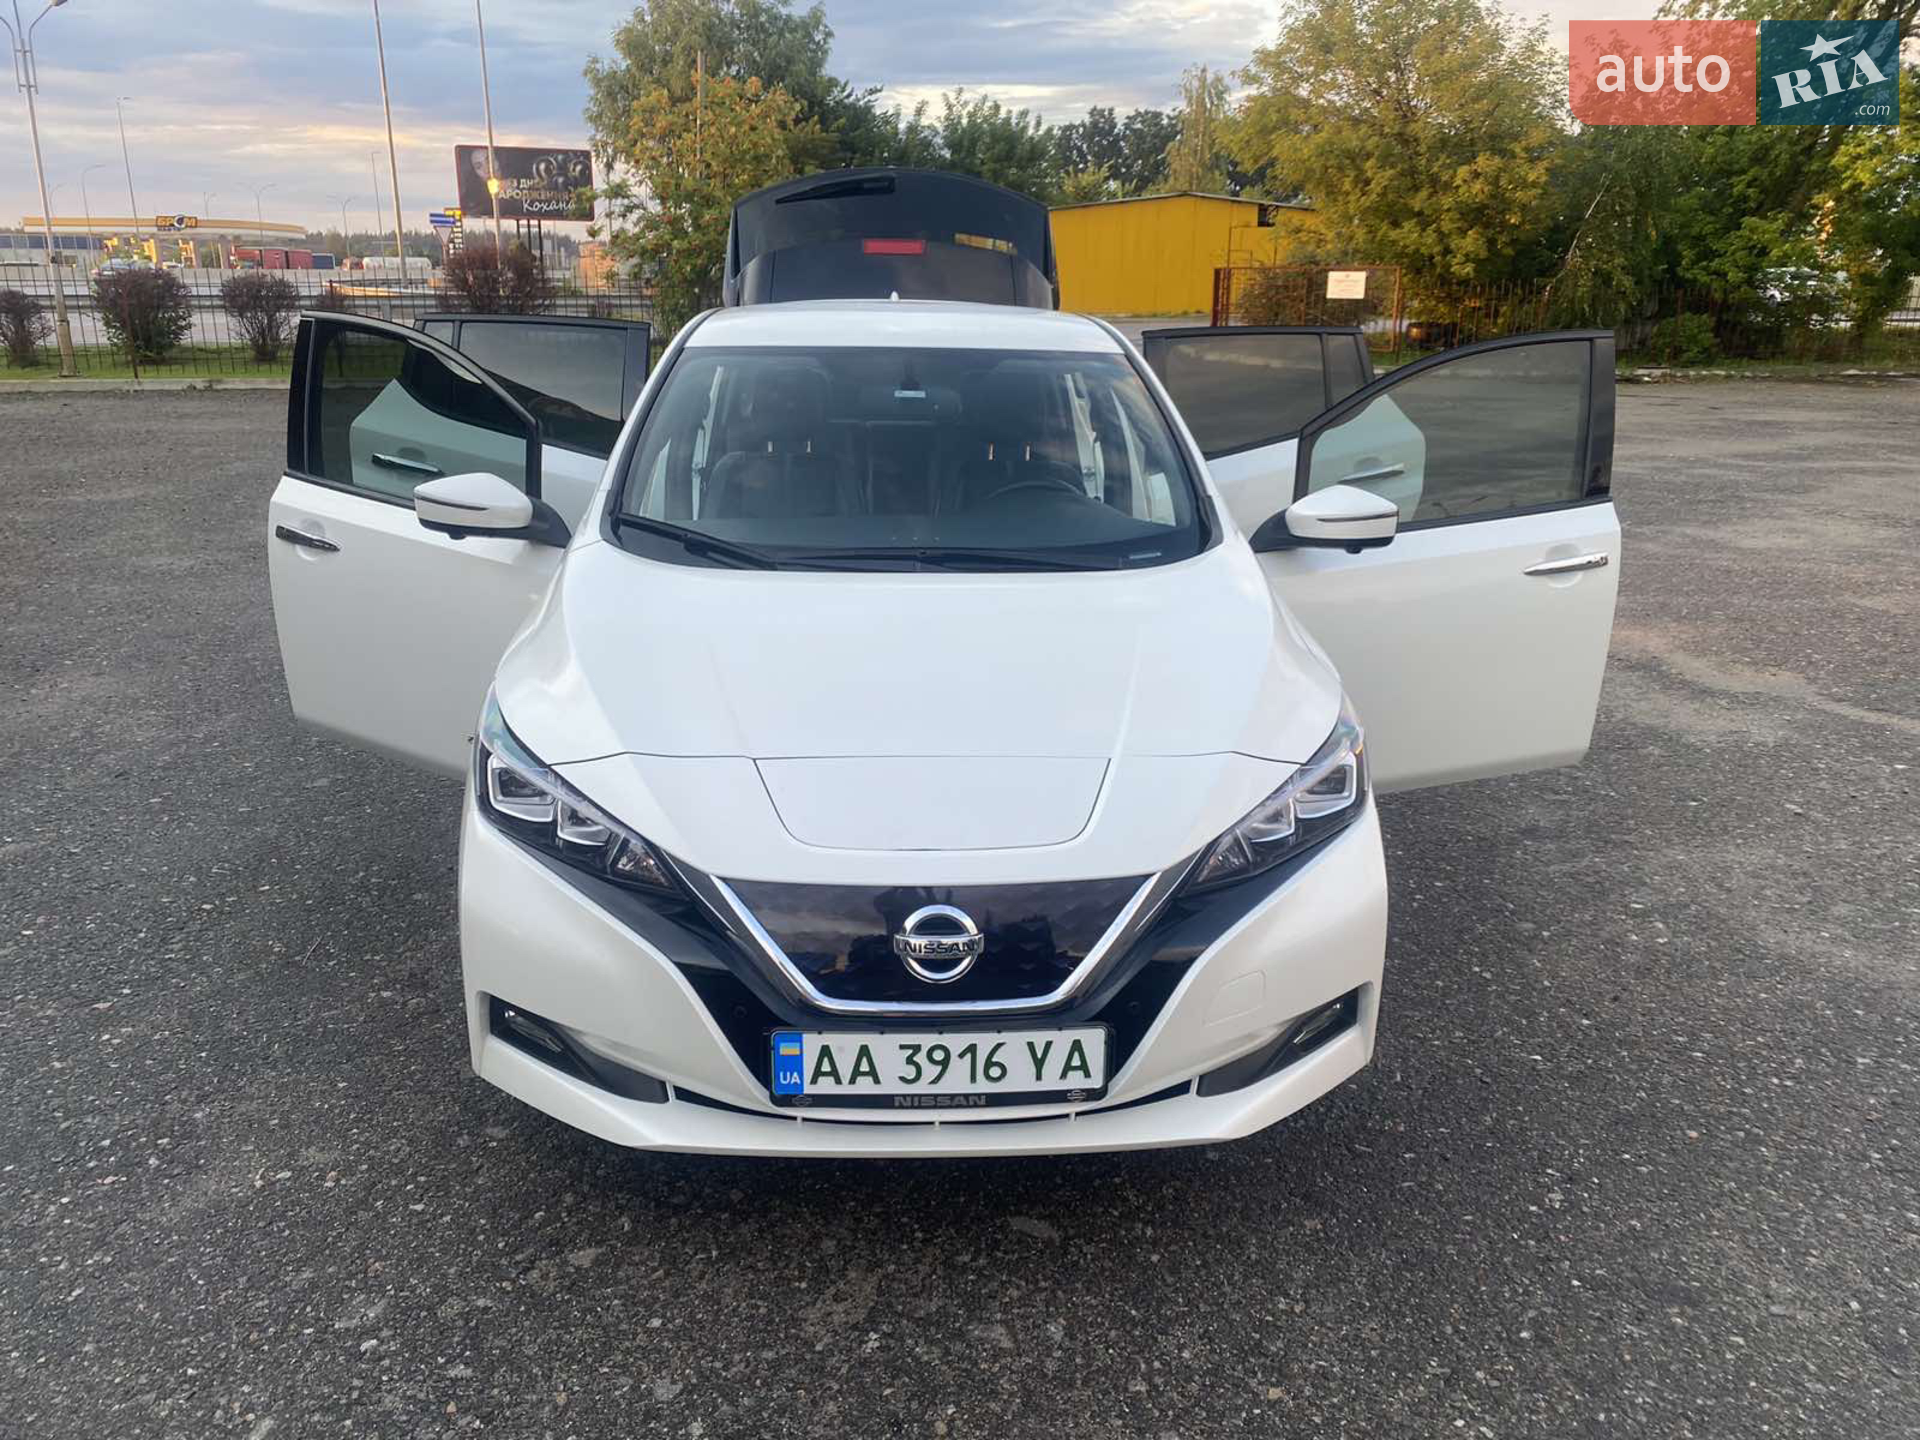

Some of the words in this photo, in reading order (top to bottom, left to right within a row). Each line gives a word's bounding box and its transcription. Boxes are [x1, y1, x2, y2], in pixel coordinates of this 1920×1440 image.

[903, 941, 975, 954] NISSAN
[809, 1043, 882, 1086] AA
[898, 1041, 1007, 1086] 3916
[1026, 1038, 1092, 1082] YA
[780, 1071, 801, 1085] UA
[893, 1094, 987, 1107] NISSAN
